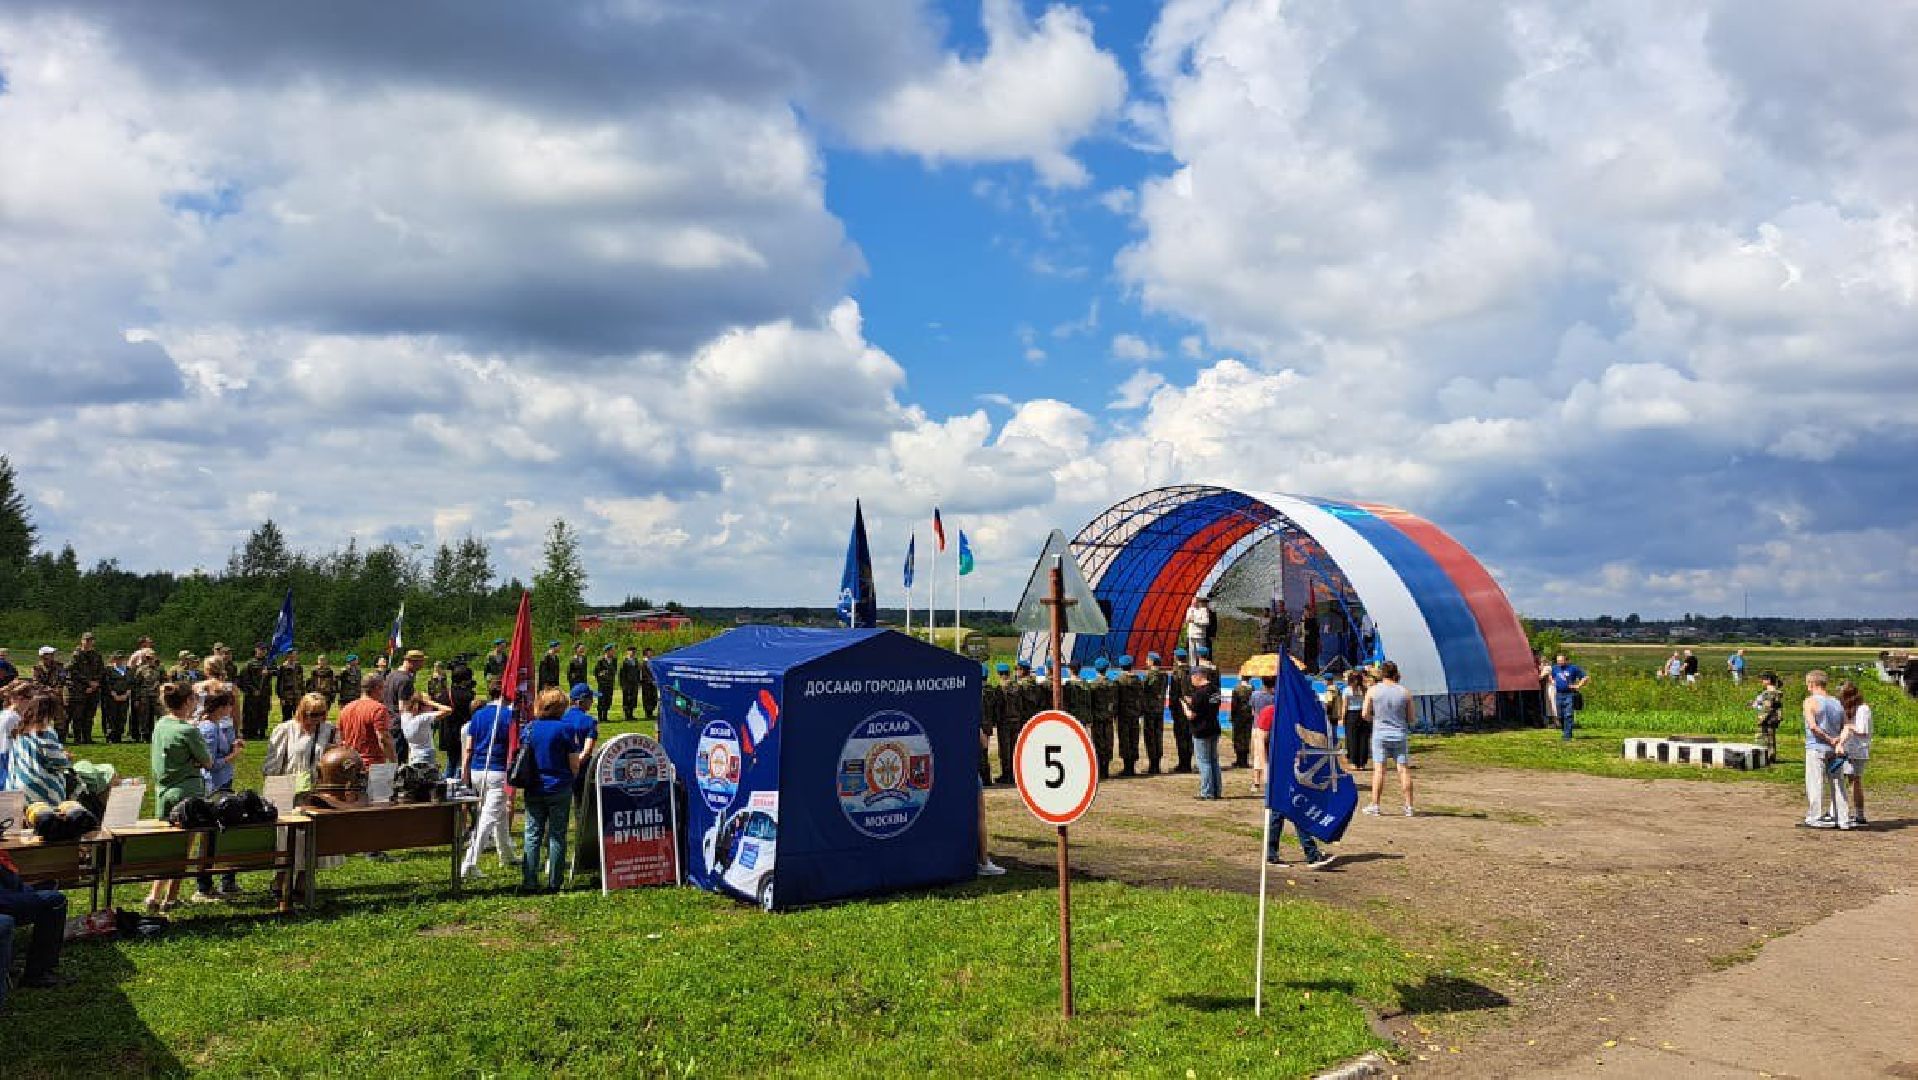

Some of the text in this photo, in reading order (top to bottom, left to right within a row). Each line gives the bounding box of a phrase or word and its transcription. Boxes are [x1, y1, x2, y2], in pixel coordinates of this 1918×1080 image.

[804, 675, 966, 697] ДОСААФ ГОРОДА МОСКВЫ
[867, 720, 910, 735] ДОСААФ
[1045, 745, 1065, 788] 5
[613, 808, 664, 828] СТАНЬ
[865, 811, 908, 827] МОСКВЫ
